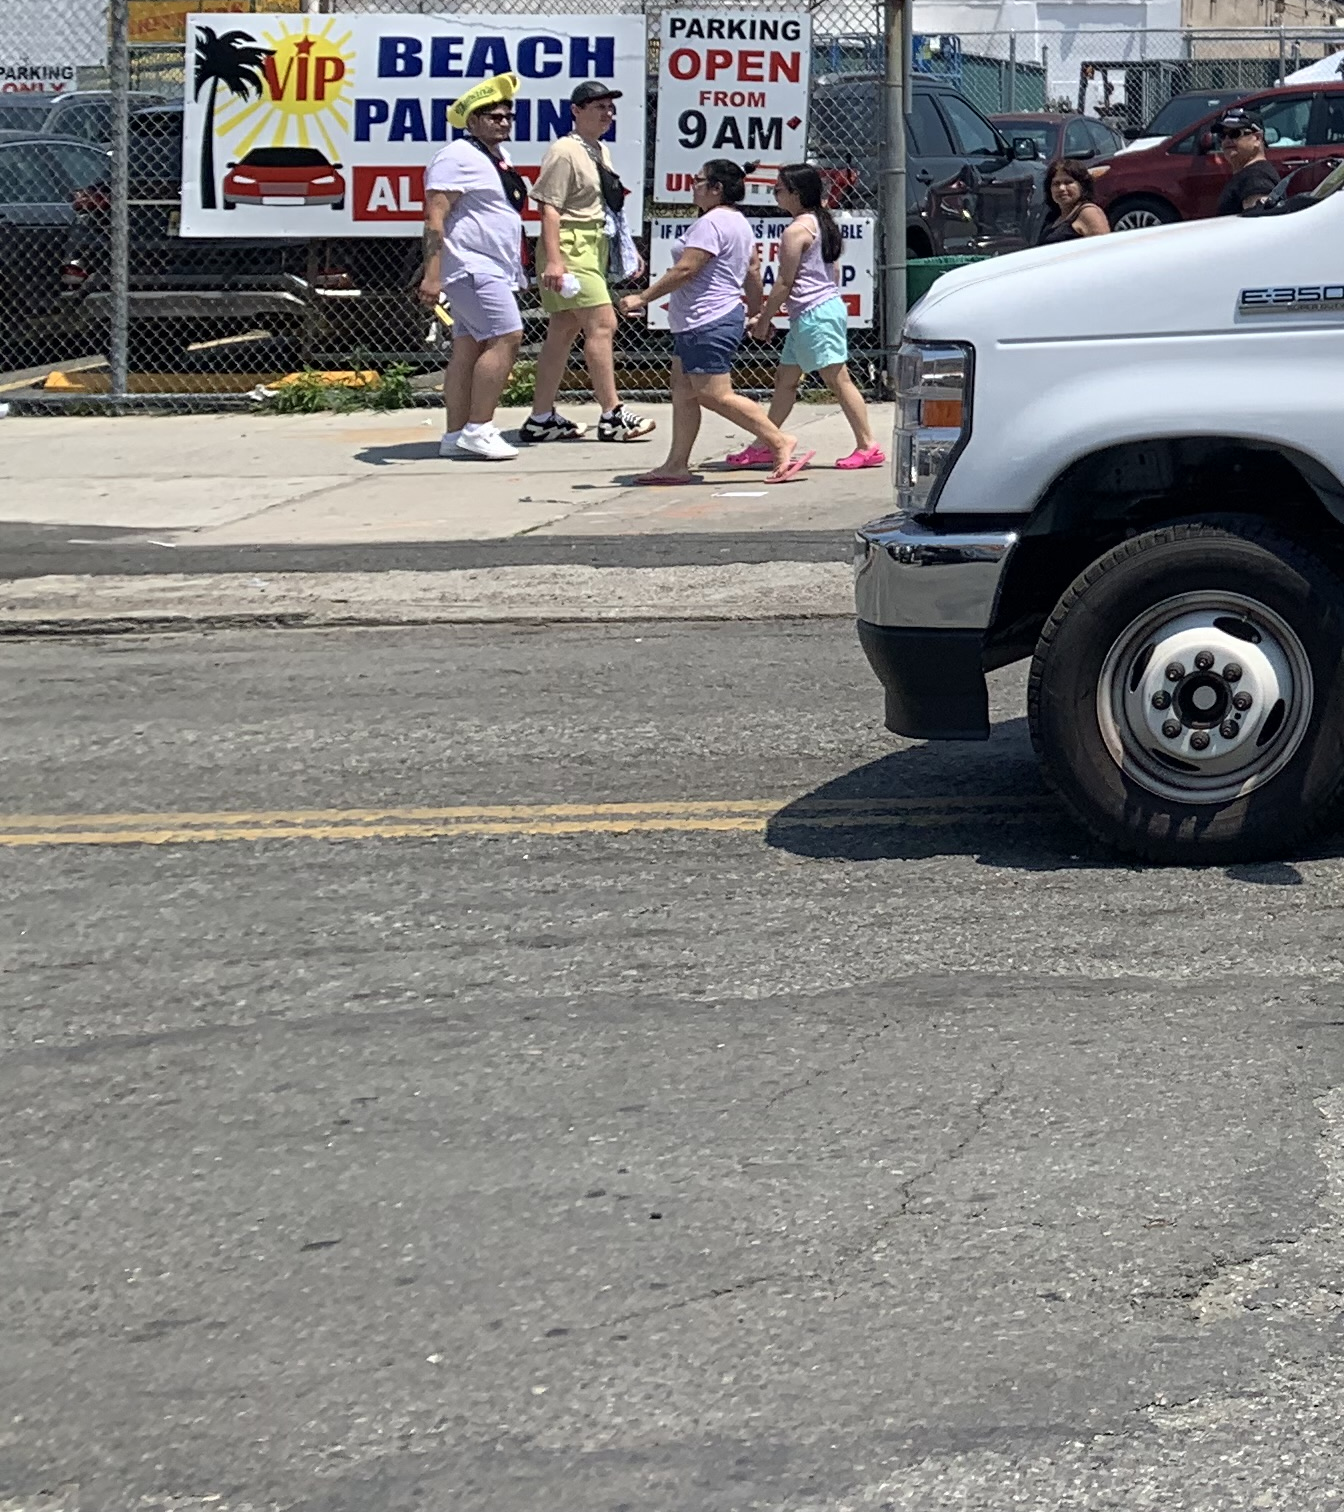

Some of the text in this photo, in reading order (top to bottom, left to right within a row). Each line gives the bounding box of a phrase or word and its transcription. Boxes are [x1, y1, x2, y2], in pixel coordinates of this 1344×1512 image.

[669, 17, 801, 41] PARKING
[377, 36, 615, 78] BEACH
[668, 47, 801, 83] OPEN
[263, 53, 345, 102] VIP
[699, 90, 766, 108] FROM
[660, 224, 674, 239] IF
